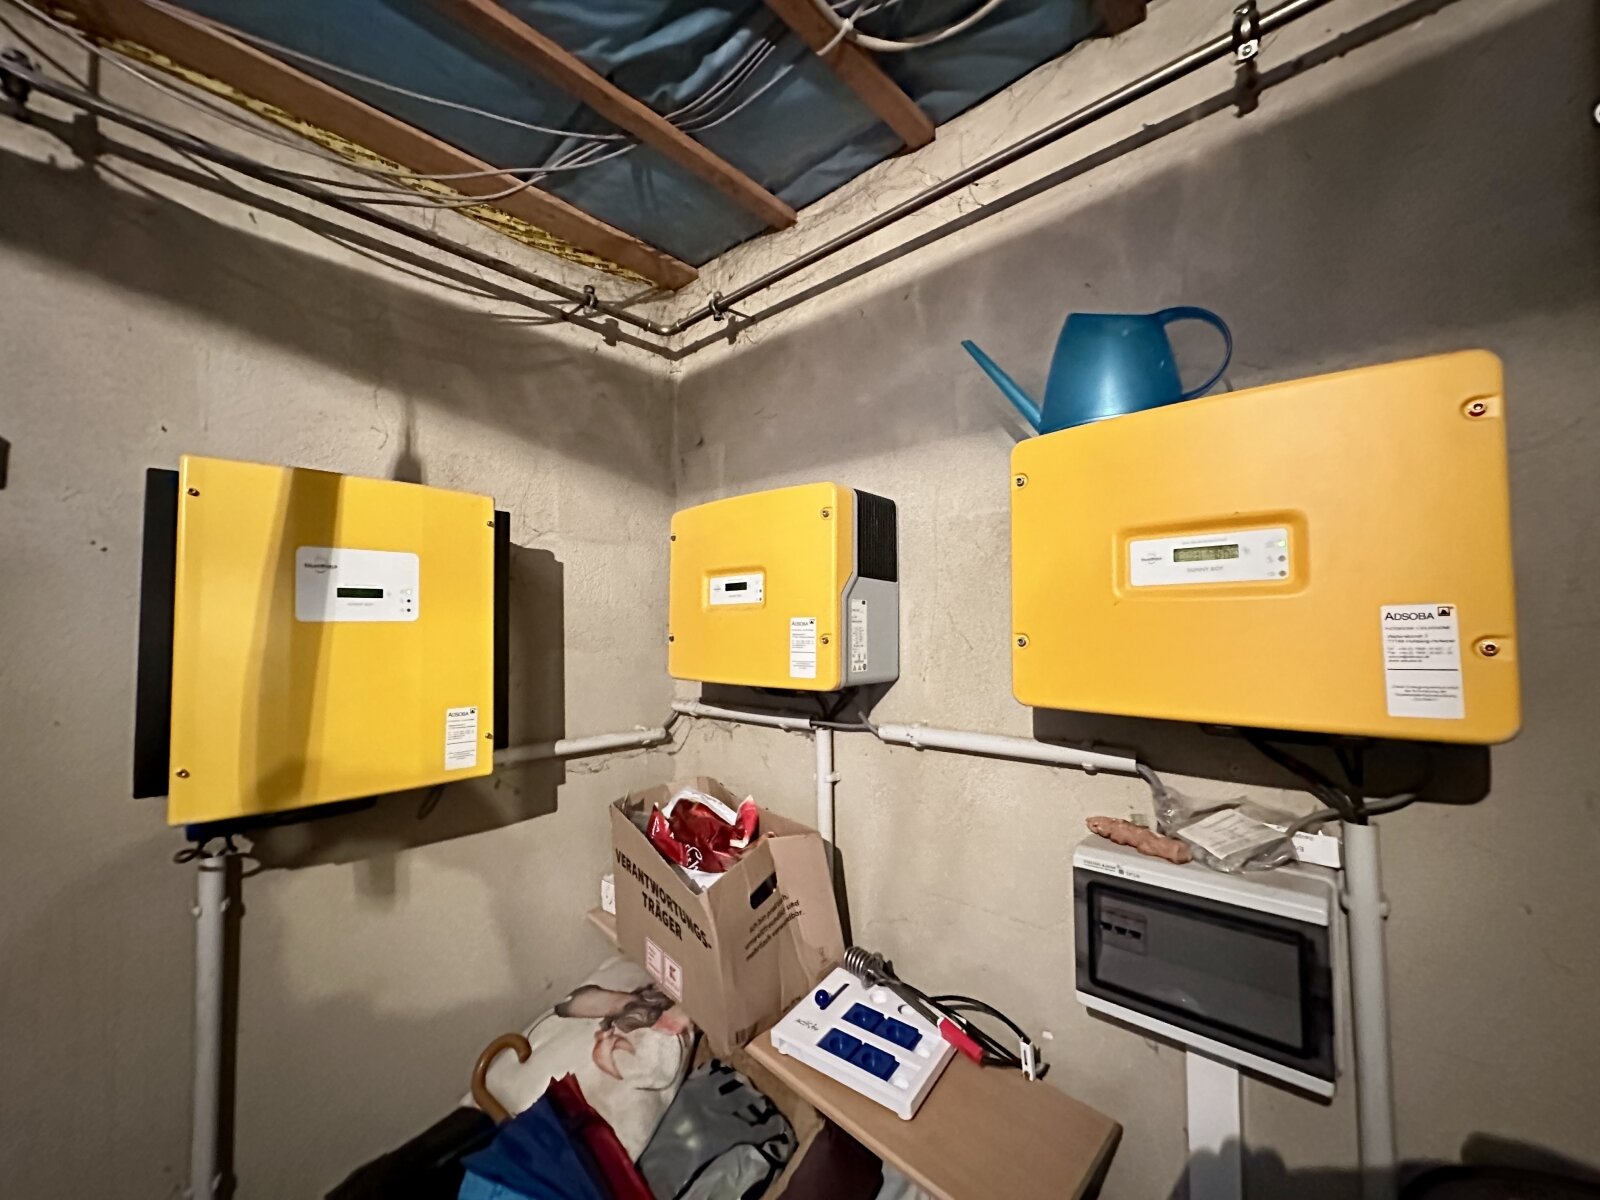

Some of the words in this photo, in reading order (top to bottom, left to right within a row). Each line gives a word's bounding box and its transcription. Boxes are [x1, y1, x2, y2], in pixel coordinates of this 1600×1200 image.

[1384, 612, 1435, 621] ADSOBA
[616, 848, 712, 949] VERANTWORTUNGS-
[642, 890, 683, 941] TRÄGER
